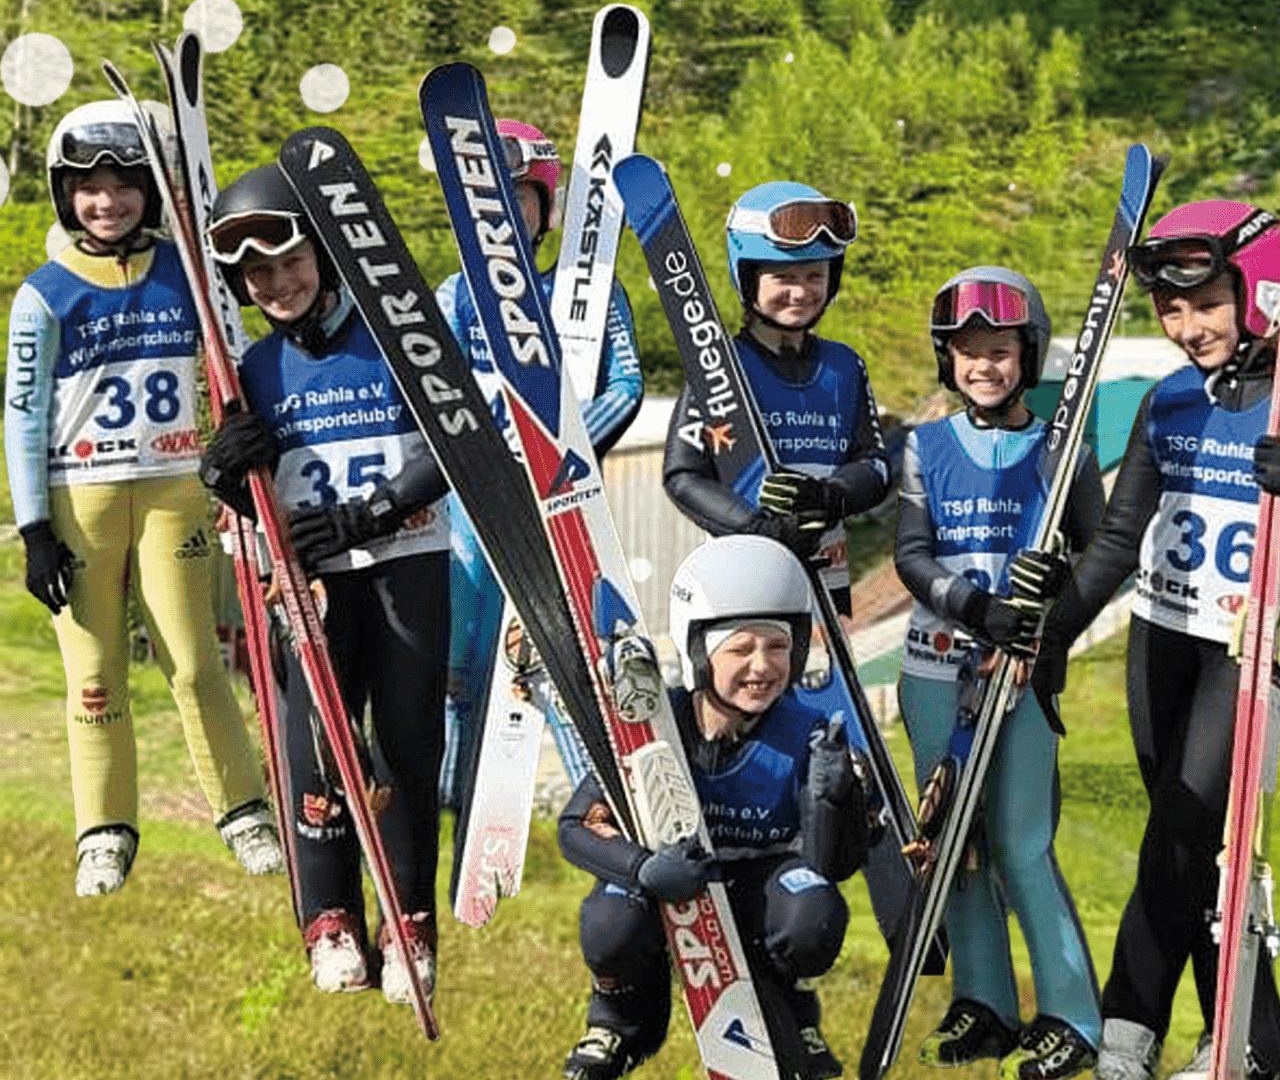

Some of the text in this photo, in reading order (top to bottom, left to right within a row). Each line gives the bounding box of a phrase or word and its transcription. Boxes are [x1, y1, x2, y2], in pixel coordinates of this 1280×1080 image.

[444, 116, 551, 368] SPORTEN
[319, 182, 480, 436] SPORTEN
[664, 250, 738, 418] fluege.de
[9, 330, 38, 414] Audi
[94, 370, 181, 430] 38
[305, 387, 354, 407] Ruhla
[1166, 435, 1255, 461] TSG Ruhla
[1166, 510, 1257, 584] 36
